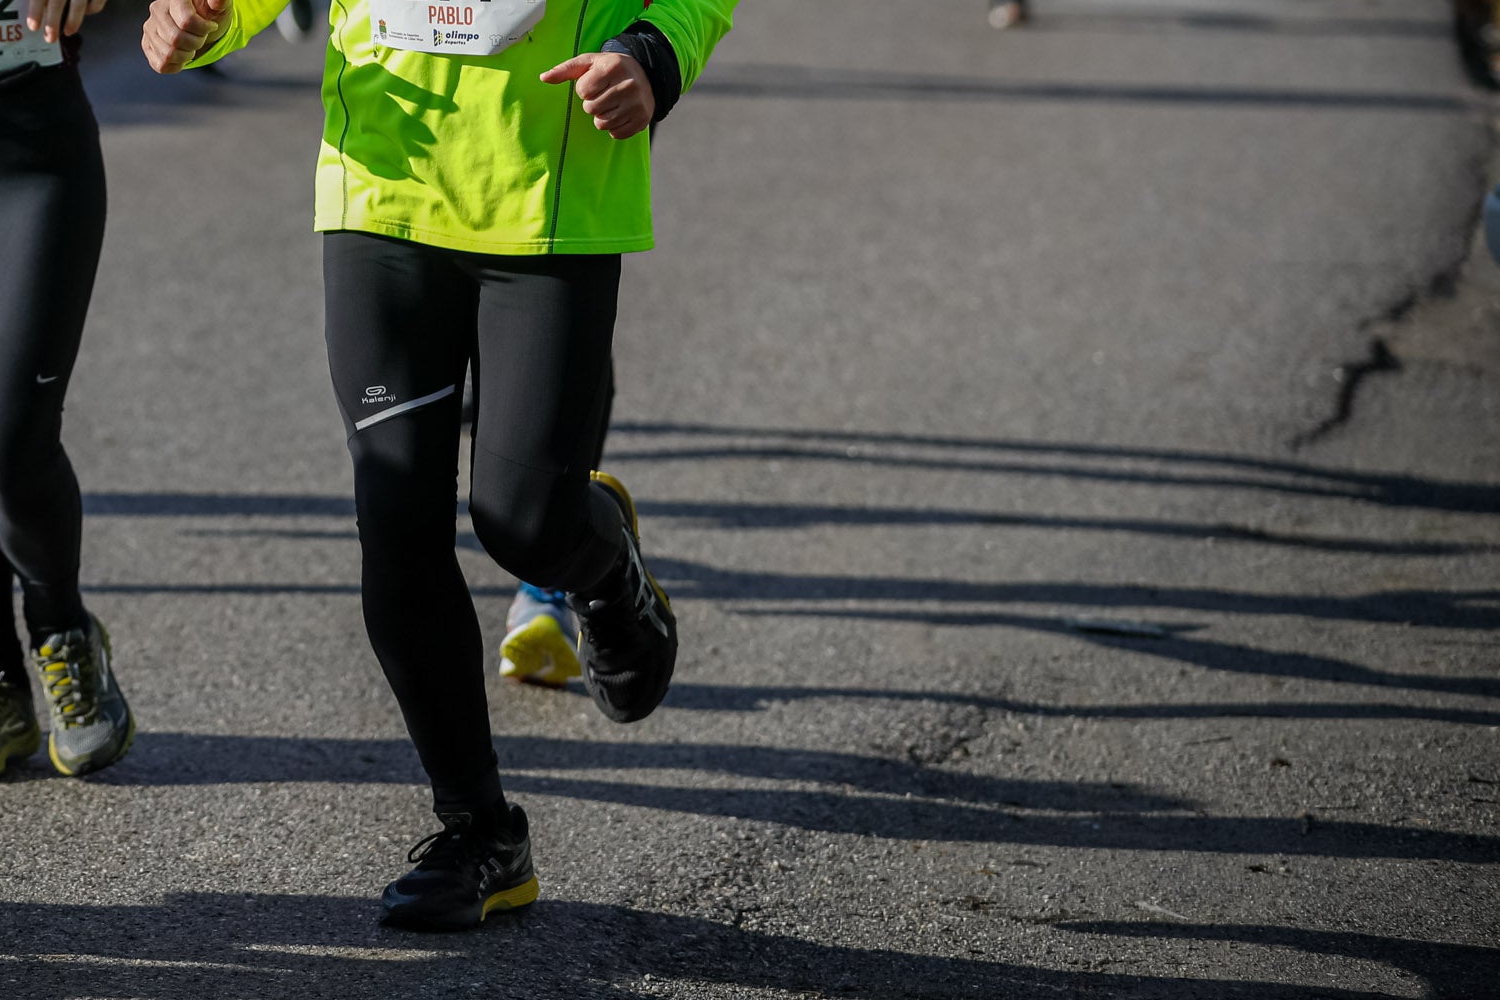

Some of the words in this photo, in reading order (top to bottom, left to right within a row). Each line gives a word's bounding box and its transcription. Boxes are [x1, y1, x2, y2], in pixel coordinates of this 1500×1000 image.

[428, 5, 473, 26] PABLO
[445, 30, 480, 42] olimpo
[361, 393, 397, 405] Kalenji
